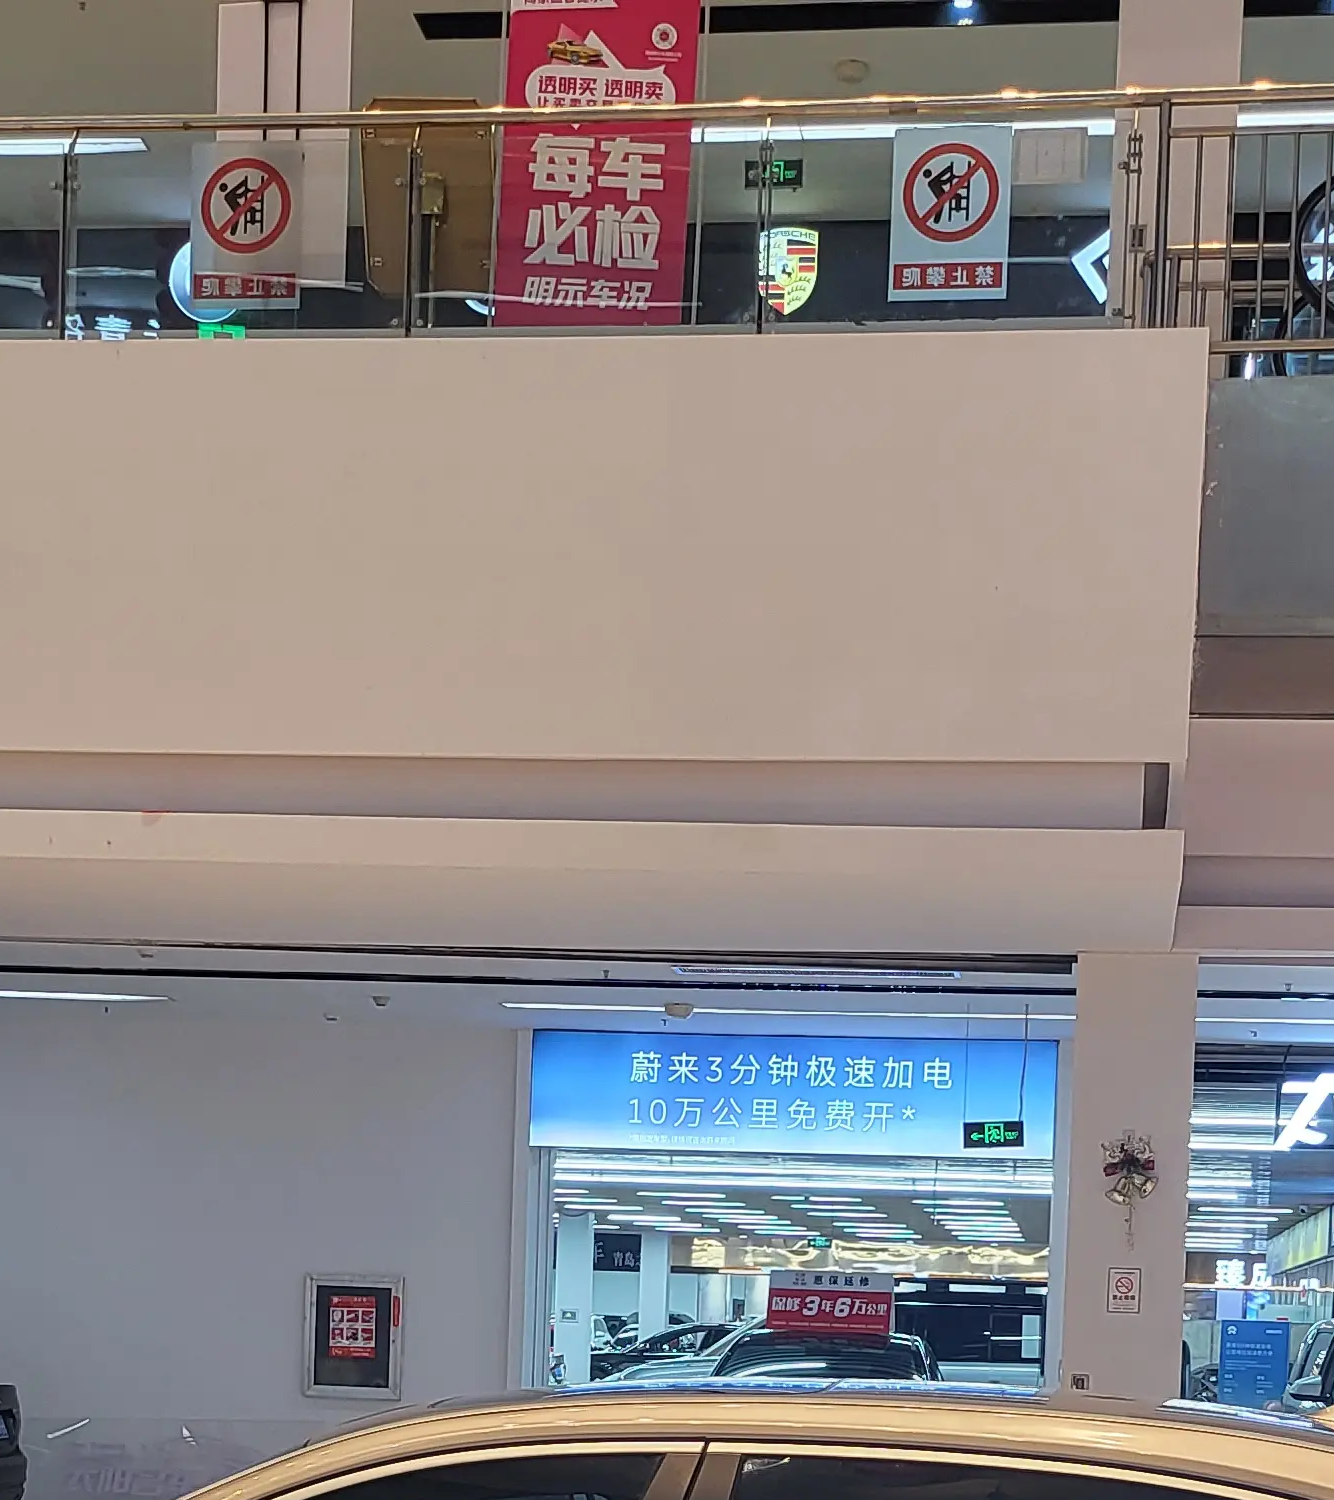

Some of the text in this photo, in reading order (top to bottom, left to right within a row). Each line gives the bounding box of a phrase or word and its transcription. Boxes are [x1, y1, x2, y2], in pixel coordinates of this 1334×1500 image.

[538, 76, 664, 100] 透明买 透明卖
[528, 133, 666, 201] 每车
[523, 201, 661, 270] 必检
[522, 276, 653, 311] 明示车况
[629, 1050, 954, 1090] 蔚来3分钟极速加电
[613, 1250, 641, 1268] 青岛
